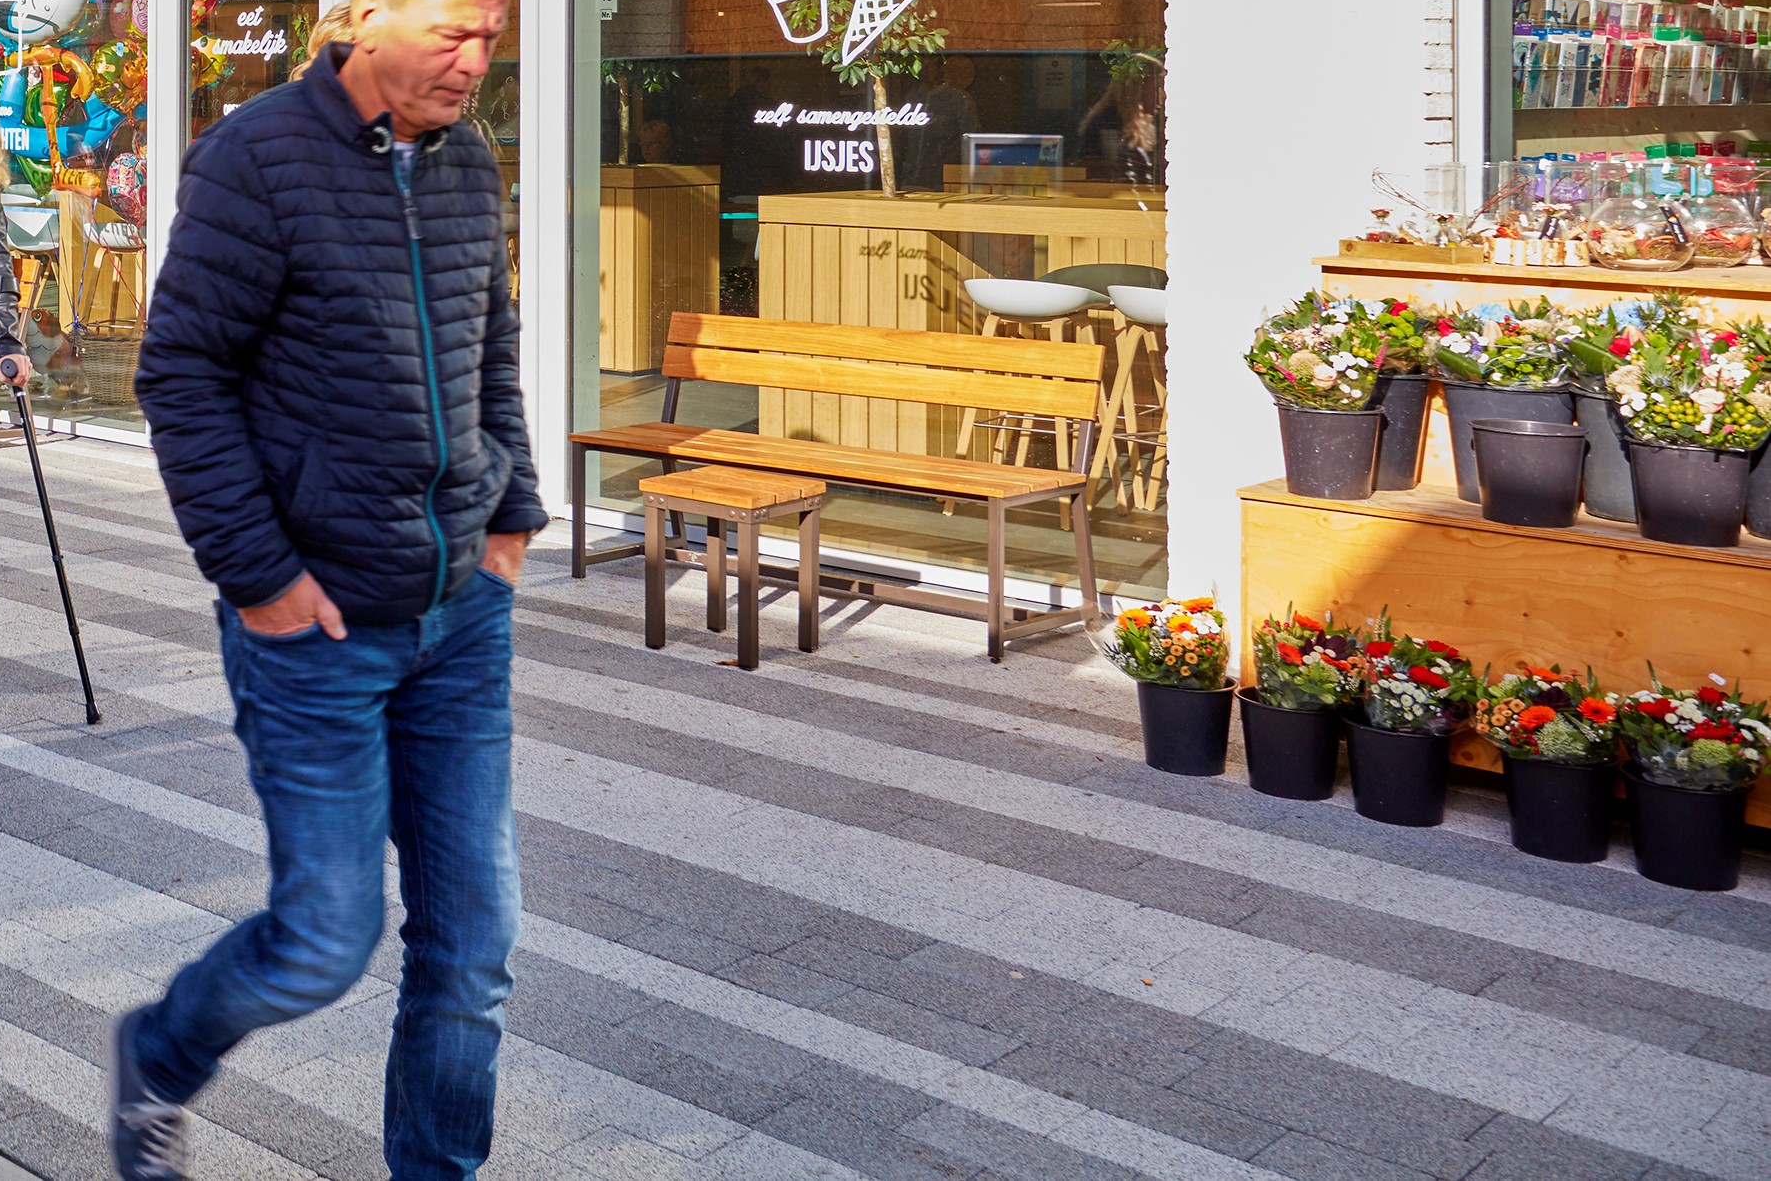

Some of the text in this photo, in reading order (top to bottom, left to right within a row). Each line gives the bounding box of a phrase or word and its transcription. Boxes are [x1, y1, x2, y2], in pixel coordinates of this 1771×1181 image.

[237, 5, 265, 27] eet
[601, 11, 611, 19] Nr.
[212, 29, 288, 61] smakelijk
[754, 102, 930, 131] zelf samengestelde
[803, 139, 875, 173] IJSJES
